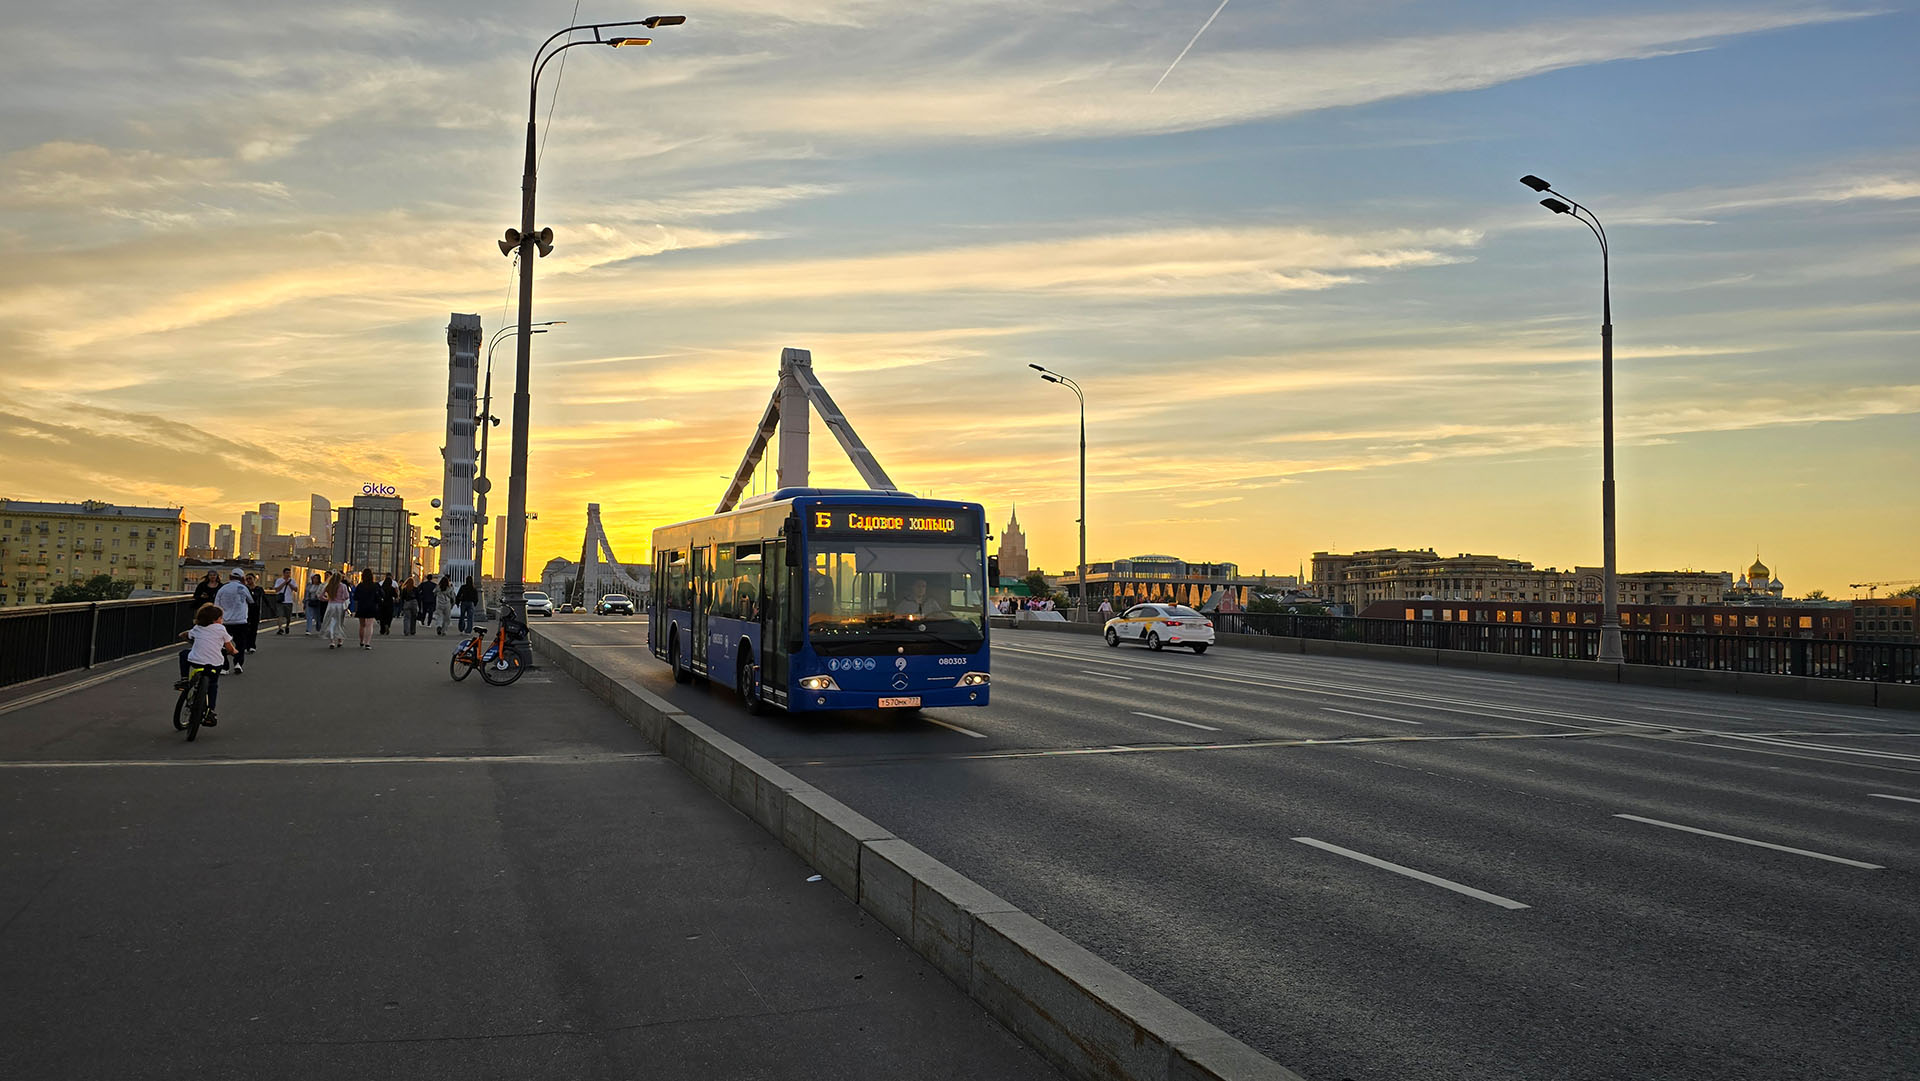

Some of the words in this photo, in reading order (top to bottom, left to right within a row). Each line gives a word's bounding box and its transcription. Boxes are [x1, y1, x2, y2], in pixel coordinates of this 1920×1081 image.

[815, 512, 832, 528] Б
[848, 513, 904, 531] Садовое
[909, 517, 955, 533] кольцо
[938, 657, 967, 665] 080303
